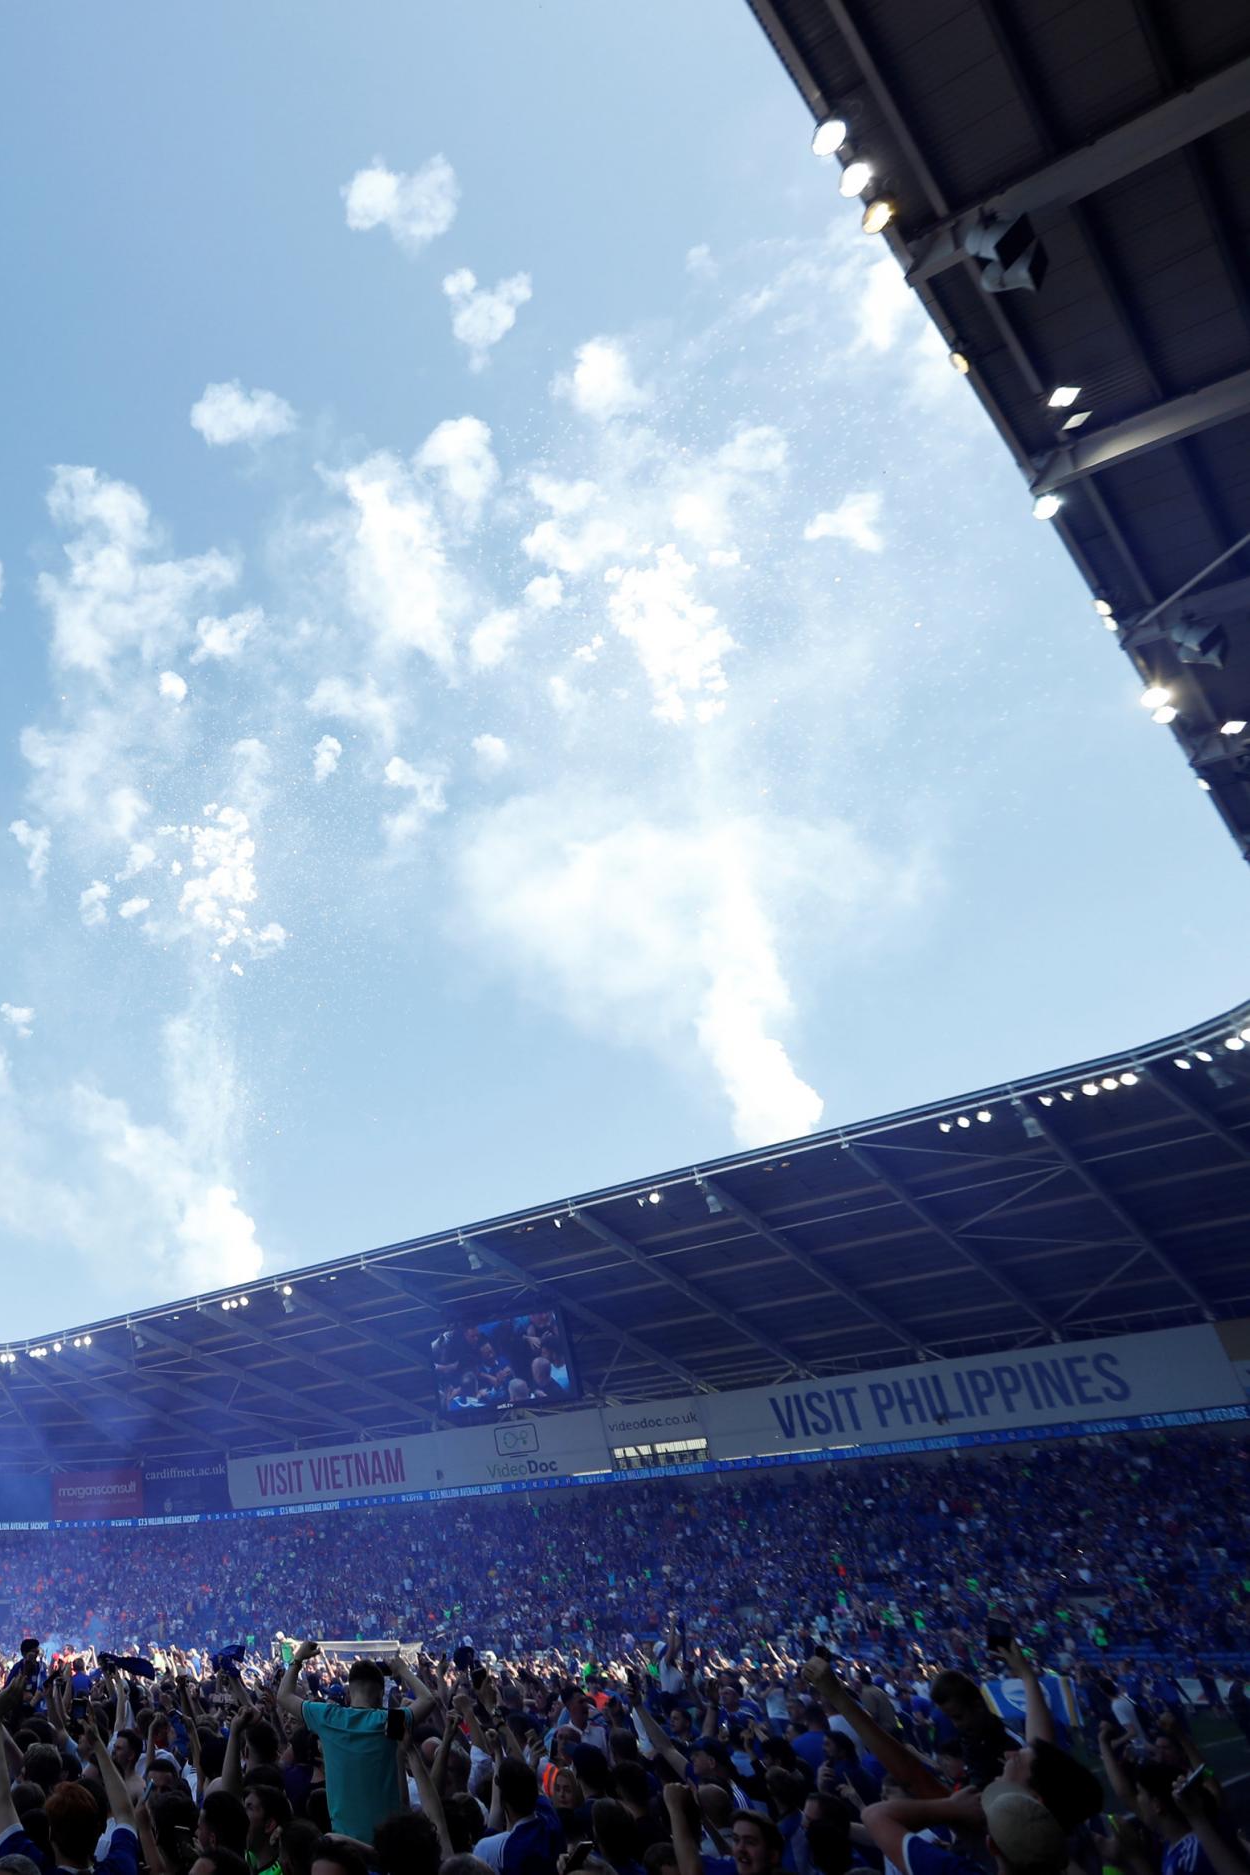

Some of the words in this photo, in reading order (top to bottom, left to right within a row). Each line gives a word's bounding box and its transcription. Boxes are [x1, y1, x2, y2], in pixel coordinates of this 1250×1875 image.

[769, 1385, 863, 1440] VISIT
[868, 1352, 1132, 1430] PHILIPPINES
[608, 1411, 699, 1433] videodoc.co.uk
[145, 1463, 227, 1481] cardiffmet.ac.uk
[256, 1460, 304, 1497] VISIT
[308, 1447, 407, 1492] VIETNAM
[486, 1459, 559, 1479] VideoDoc
[628, 1468, 650, 1480] MILLION
[650, 1466, 676, 1478] AVERAGE
[678, 1463, 703, 1475] JACKPOT
[58, 1481, 137, 1499] morgansconsult
[441, 1487, 459, 1499] MILLION
[460, 1485, 481, 1497] AVERAGE
[482, 1483, 503, 1495] JACKPOT
[288, 1503, 304, 1514] MILLION
[304, 1502, 322, 1513] AVERAGE
[322, 1500, 340, 1511] JACKPOT
[10, 1522, 29, 1531] AVERAGE
[30, 1522, 49, 1531] JACKPOT
[148, 1517, 164, 1526] MILLION
[164, 1516, 182, 1525] AVERAGE
[182, 1514, 200, 1523] JACKPOT
